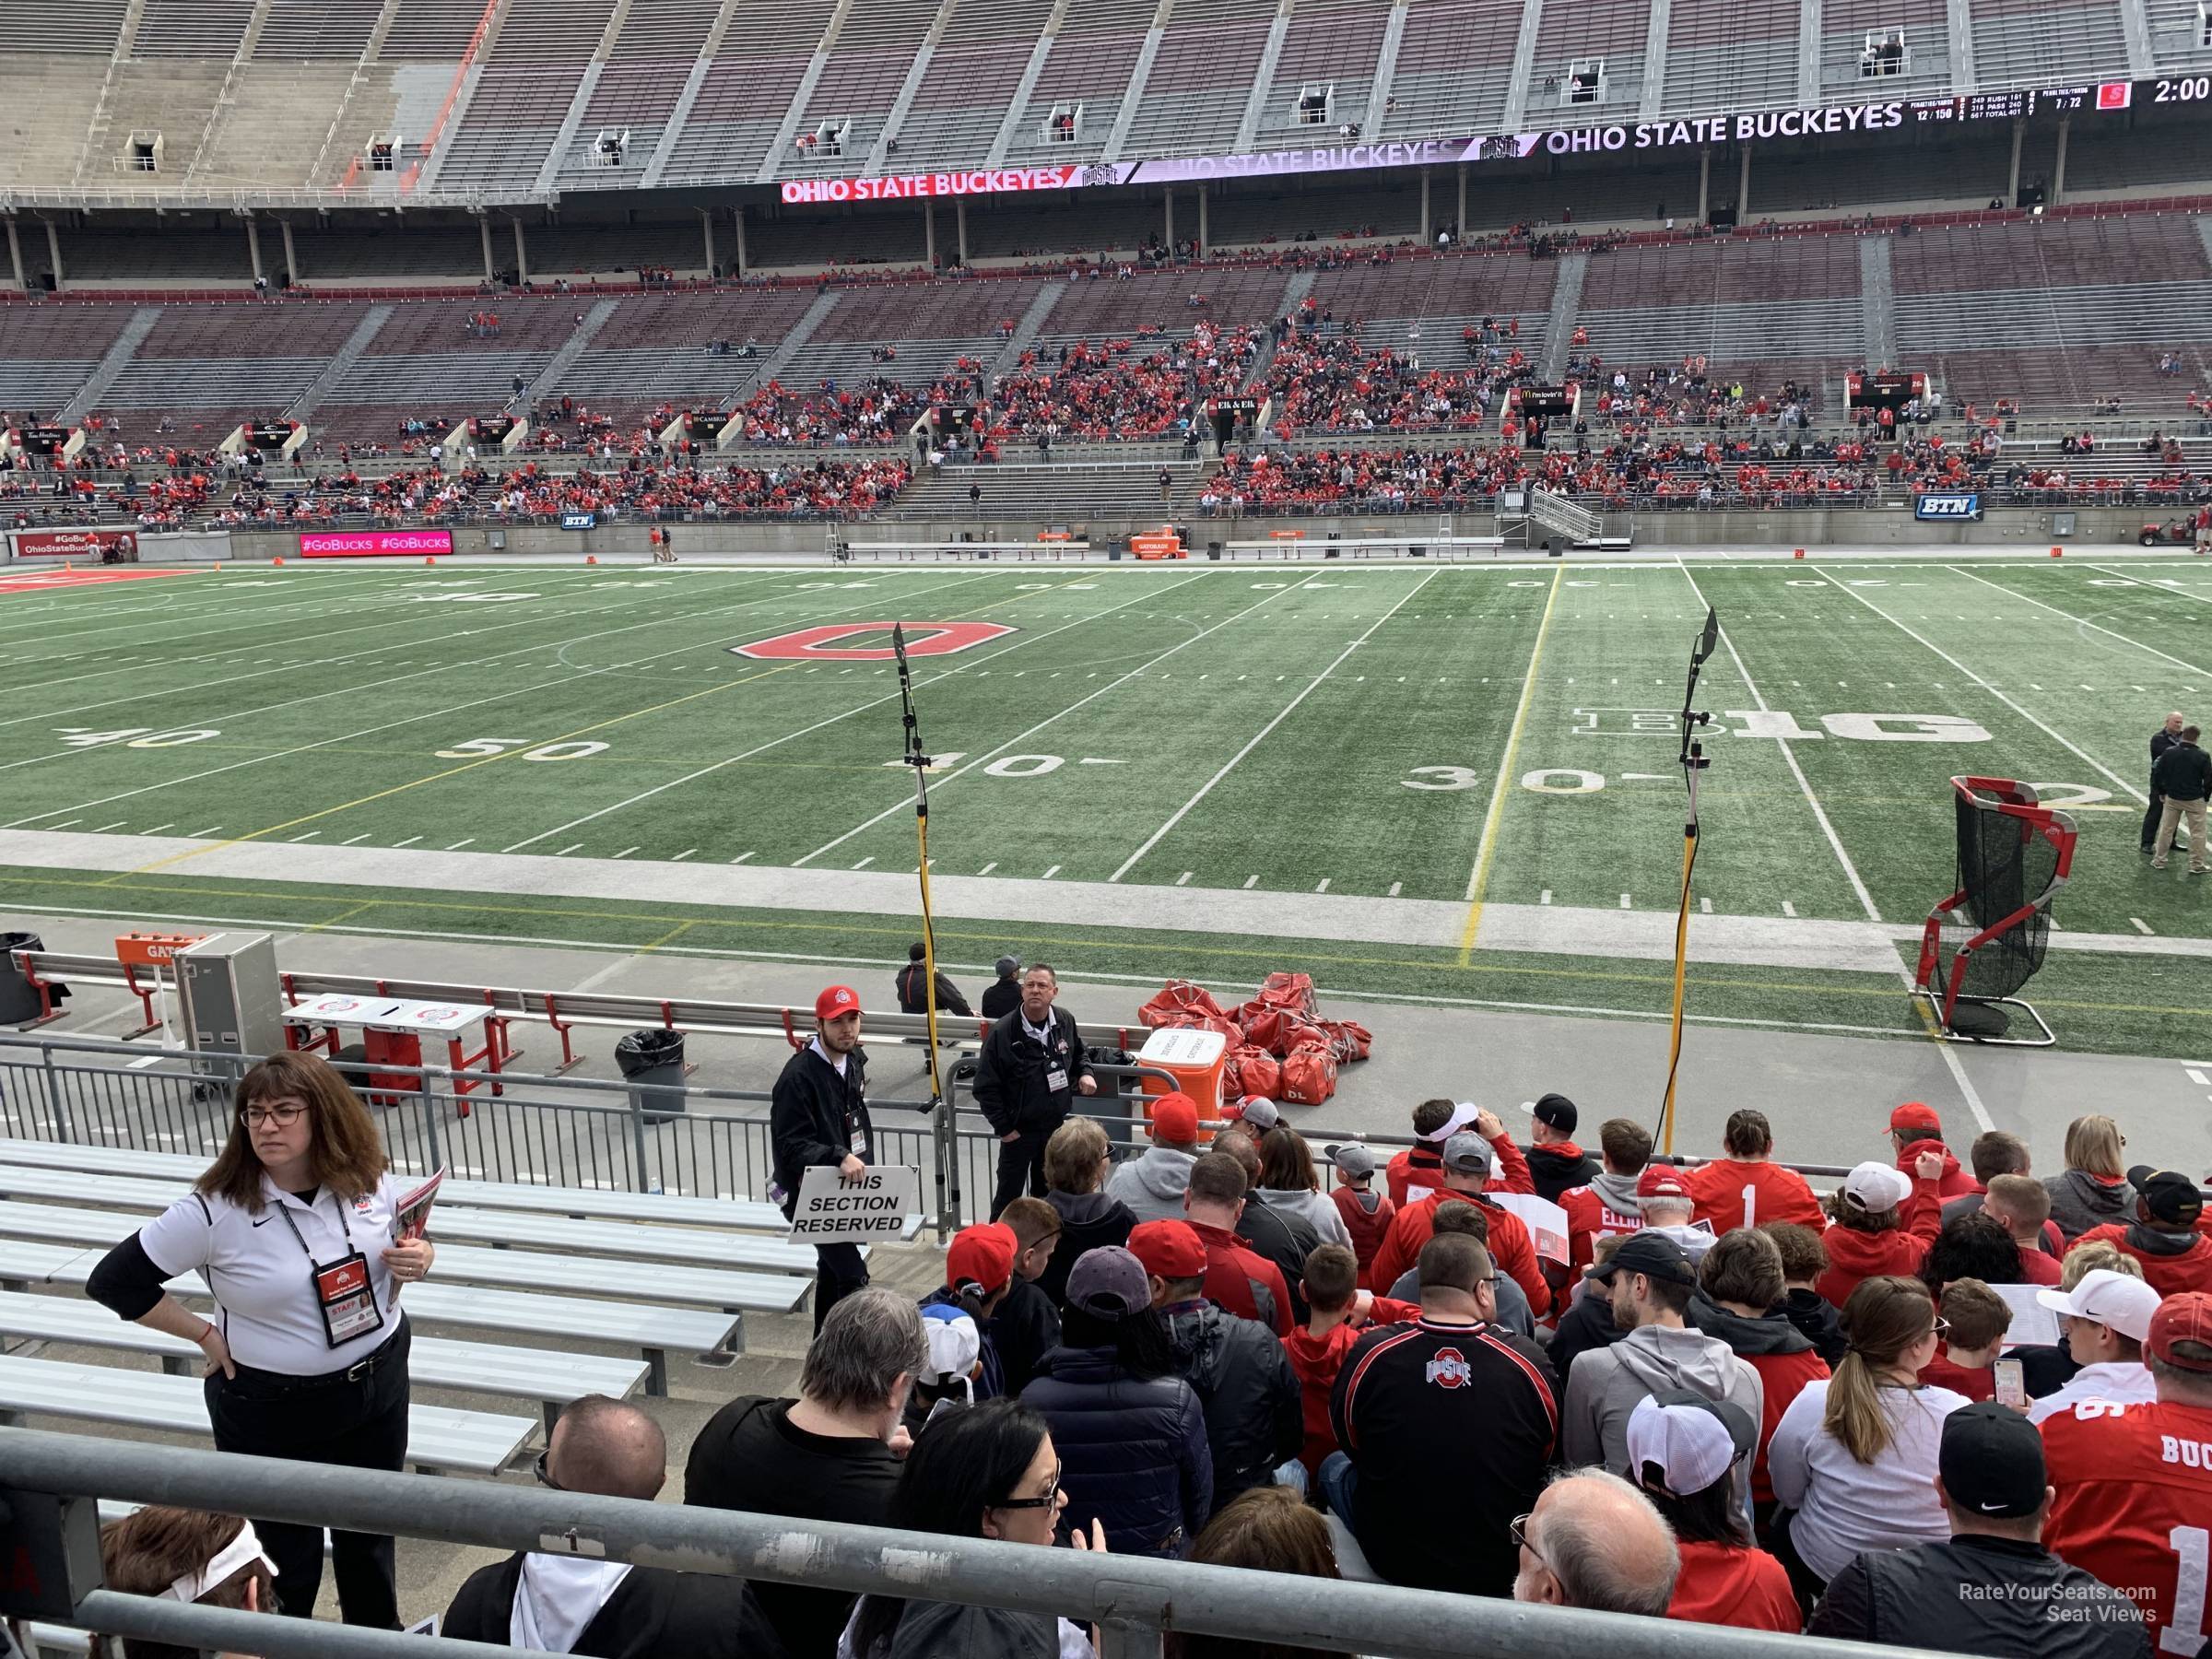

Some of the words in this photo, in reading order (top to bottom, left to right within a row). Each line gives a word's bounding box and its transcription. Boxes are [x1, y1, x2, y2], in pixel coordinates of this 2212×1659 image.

[2155, 77, 2209, 102] 2:00
[1987, 95, 2007, 103] RUSH
[2056, 98, 2062, 109] 7
[2069, 97, 2081, 108] 72
[1917, 111, 1927, 121] 12
[1936, 109, 1952, 119] 150
[1547, 126, 1627, 155] OHIO
[1634, 117, 1727, 148] STATE
[1736, 102, 1903, 139] BUCKEYES
[1224, 150, 1303, 174] STATE
[1312, 139, 1453, 169] BUCKEYES
[782, 179, 849, 203] OHIO
[854, 174, 931, 199] STATE
[935, 167, 1065, 195] BUCKEYES
[1218, 401, 1231, 409] Elk
[1232, 400, 1240, 408] &
[1241, 400, 1255, 408] Elk
[1922, 499, 1970, 513] BTN
[564, 516, 590, 526] BTN
[55, 535, 88, 543] #GoBu
[52, 728, 221, 747] 40
[434, 738, 610, 761] 50
[1400, 766, 1606, 794] 30
[1288, 1089, 1307, 1100] DL
[838, 1175, 882, 1190] THIS
[809, 1196, 899, 1212] SECTION
[1742, 1183, 1755, 1230] 1
[794, 1217, 902, 1233] RESERVED
[1602, 1207, 1645, 1229] ELLIO
[332, 1300, 356, 1315] STAFF
